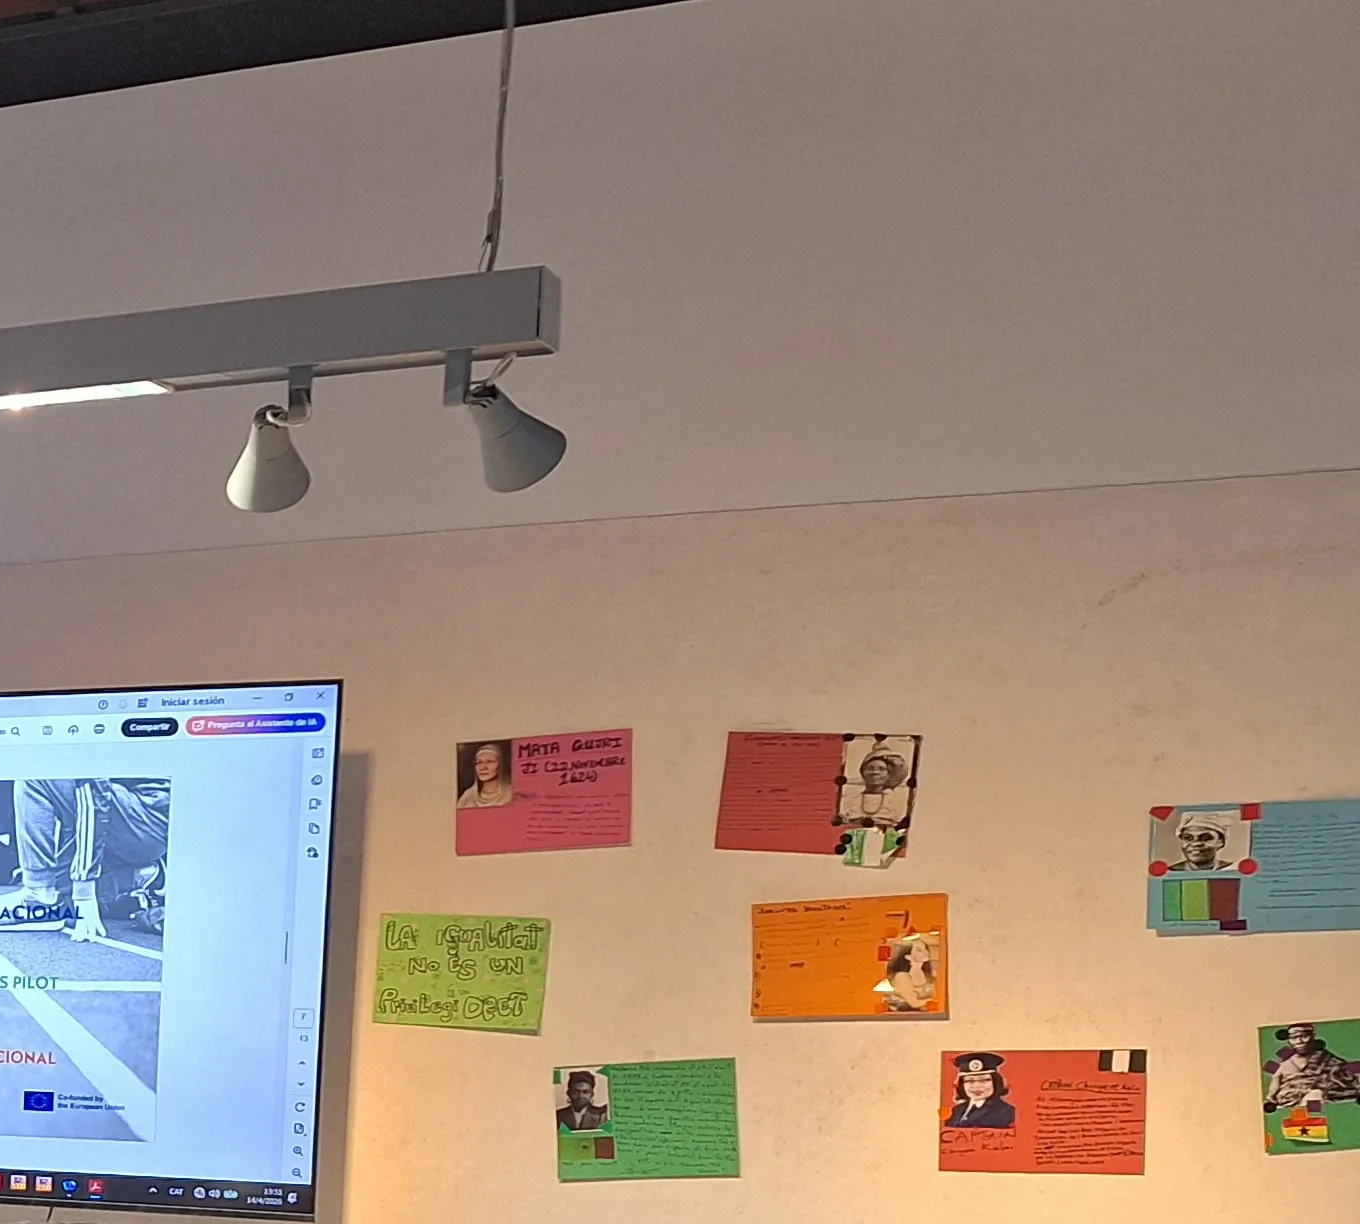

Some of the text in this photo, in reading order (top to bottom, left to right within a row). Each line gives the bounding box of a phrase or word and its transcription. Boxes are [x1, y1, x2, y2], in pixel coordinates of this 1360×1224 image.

[161, 696, 225, 707] Iniciar sesión
[518, 741, 560, 759] MATA
[385, 920, 419, 951] LA
[489, 956, 524, 975] UN
[12, 976, 59, 990] PILOT
[300, 1013, 306, 1021] 7
[168, 1187, 184, 1196] CAT
